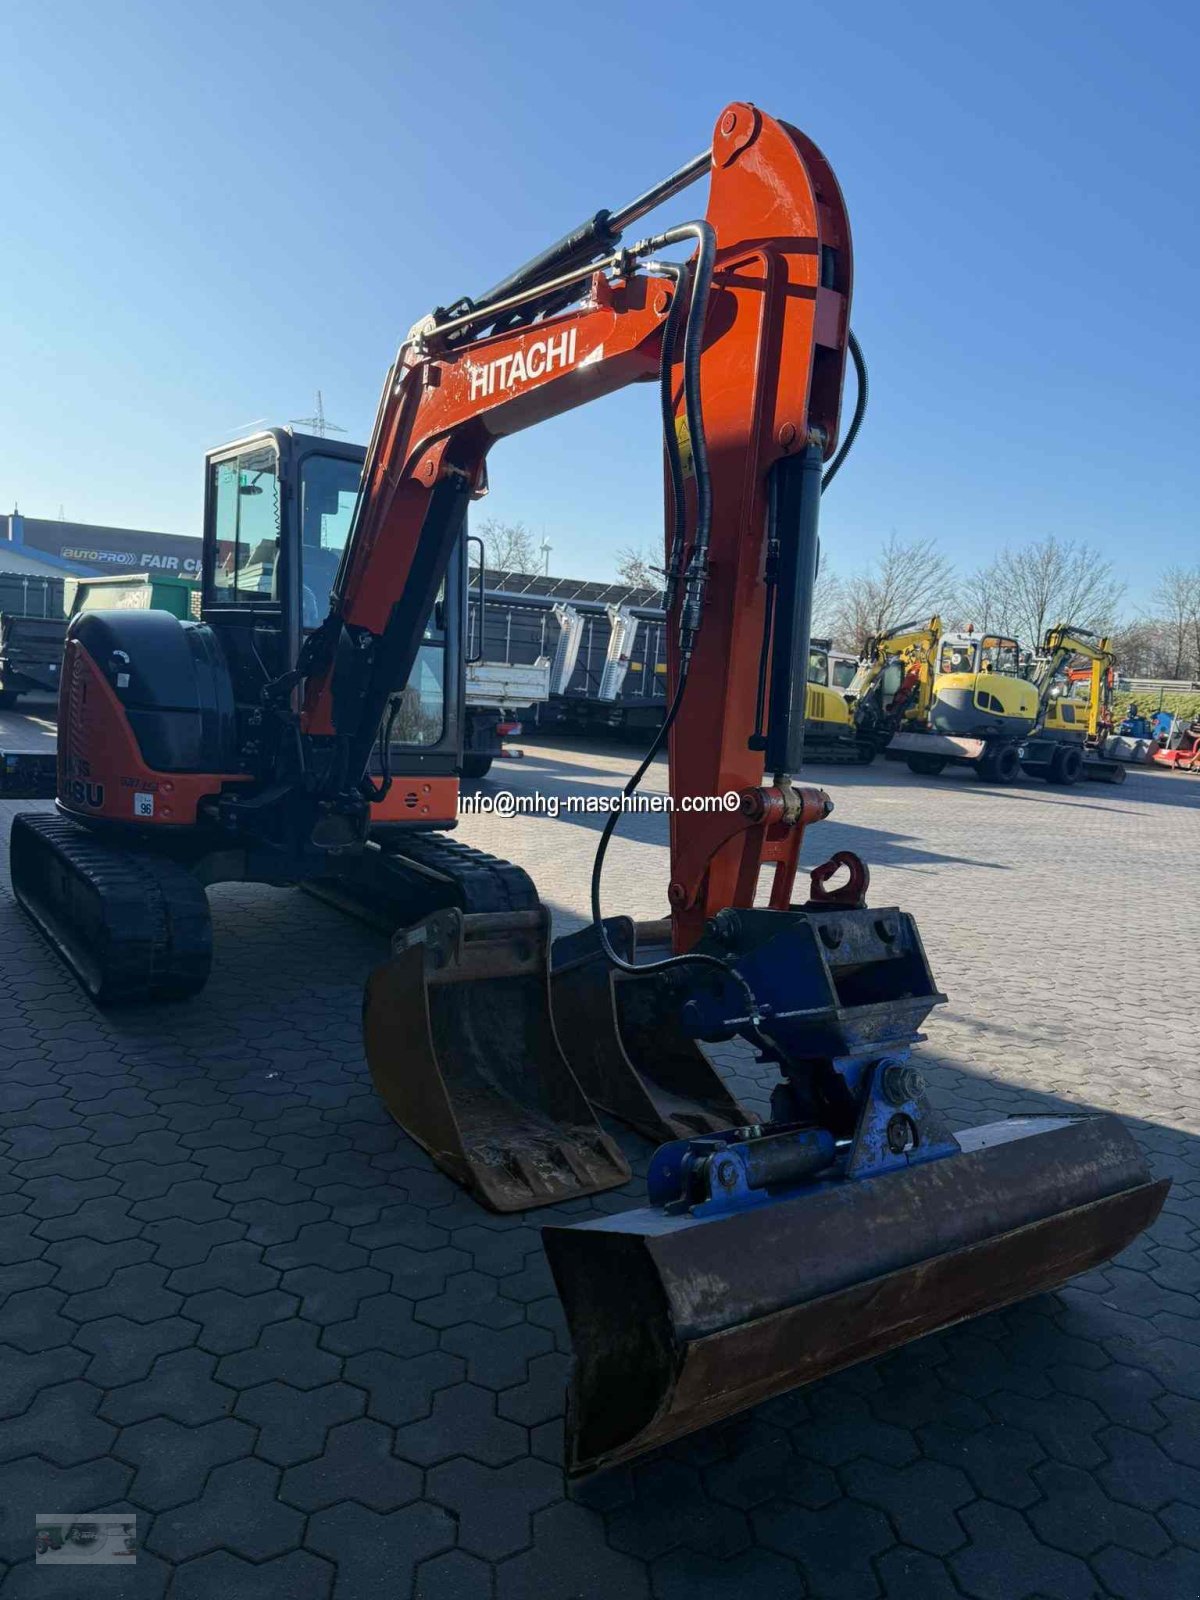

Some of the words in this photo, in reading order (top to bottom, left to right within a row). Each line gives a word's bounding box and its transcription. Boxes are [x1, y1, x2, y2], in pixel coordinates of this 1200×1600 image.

[471, 328, 577, 401] HITACHI
[140, 553, 178, 569] FAIR
[140, 803, 152, 814] 96
